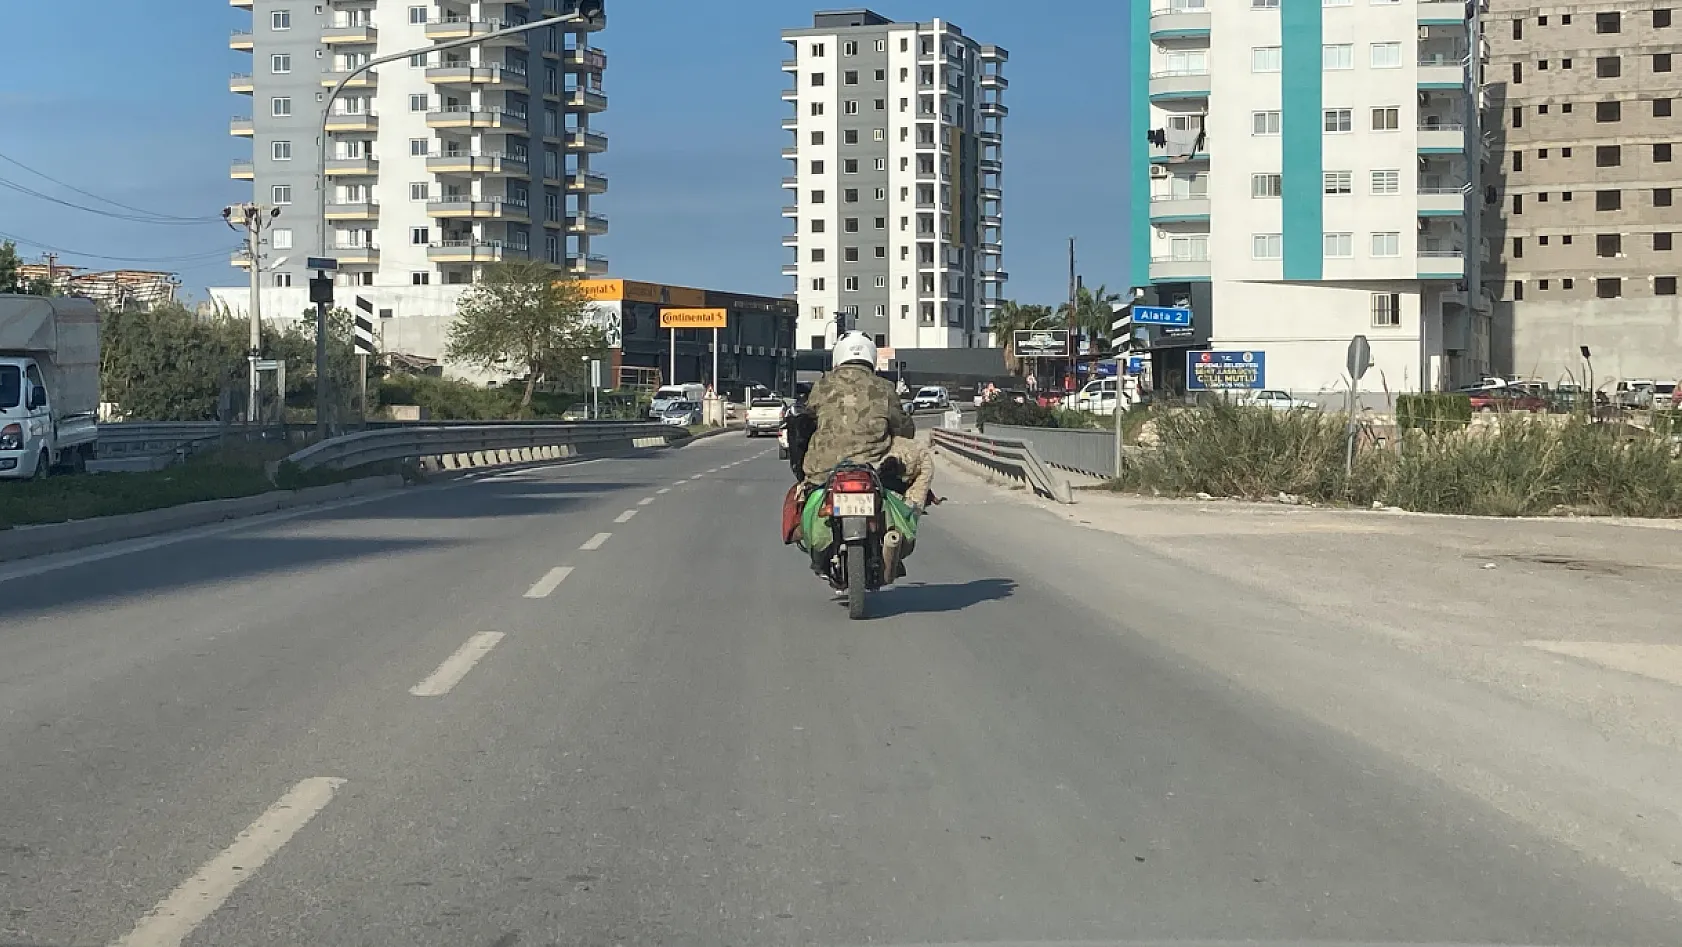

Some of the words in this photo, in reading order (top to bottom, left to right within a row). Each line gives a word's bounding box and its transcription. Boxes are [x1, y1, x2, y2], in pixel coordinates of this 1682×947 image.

[662, 312, 715, 324] Continental
[1141, 310, 1171, 320] Alata
[1174, 311, 1183, 321] 2
